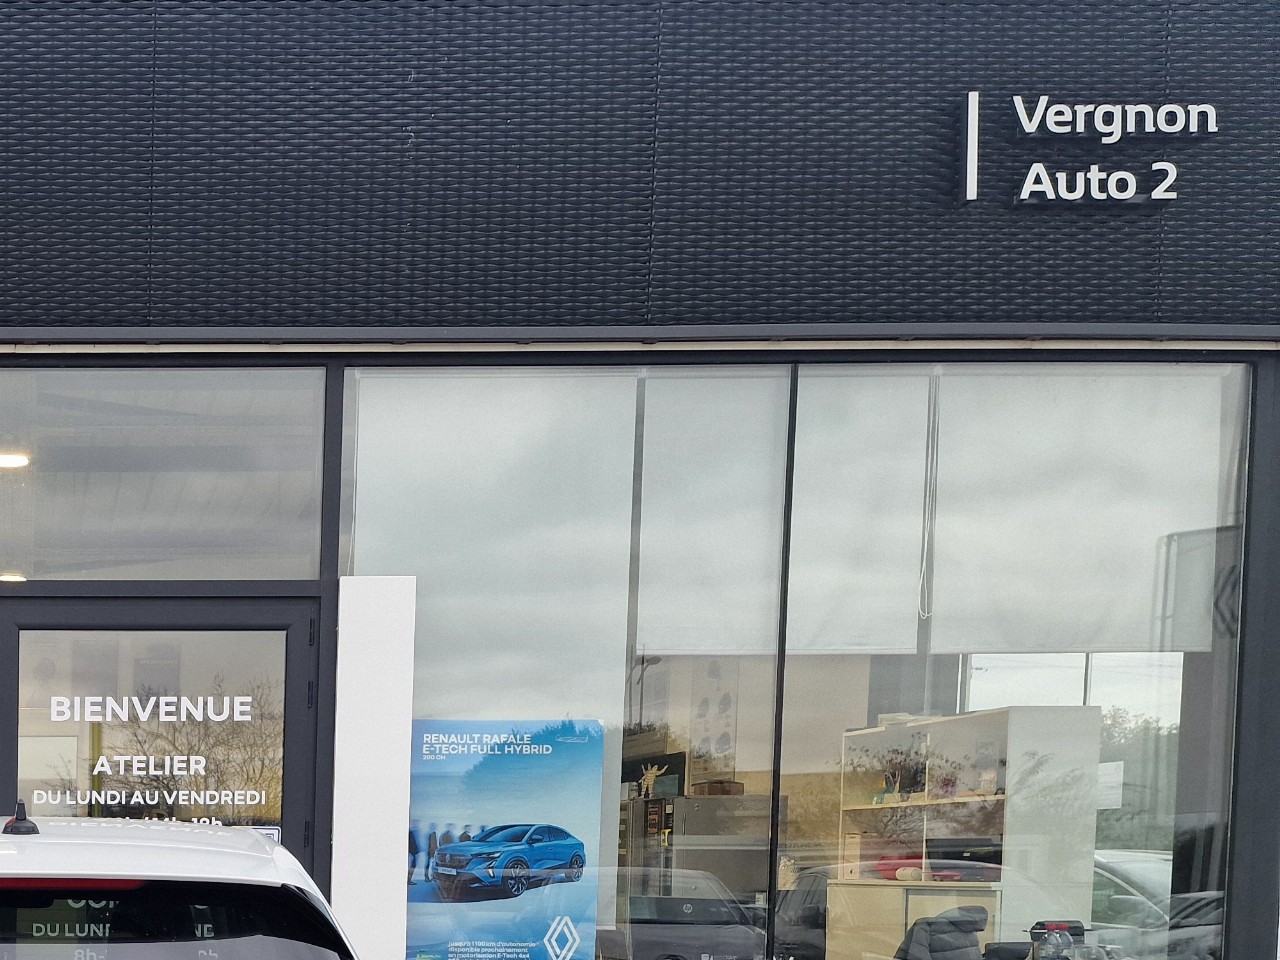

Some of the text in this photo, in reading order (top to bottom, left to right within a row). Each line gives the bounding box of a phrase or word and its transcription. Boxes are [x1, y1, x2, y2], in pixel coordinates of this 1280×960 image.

[1013, 96, 1219, 144] Vergnon
[1020, 162, 1178, 200] Auto 2
[50, 696, 253, 722] BIENVENUE
[423, 733, 532, 744] RENAULT RAFALE
[422, 744, 553, 754] E-TECH FULL HYBRID
[92, 755, 206, 776] ATELIER
[33, 790, 267, 805] DU LUNDI AU VENDREDI
[32, 923, 60, 937] DU
